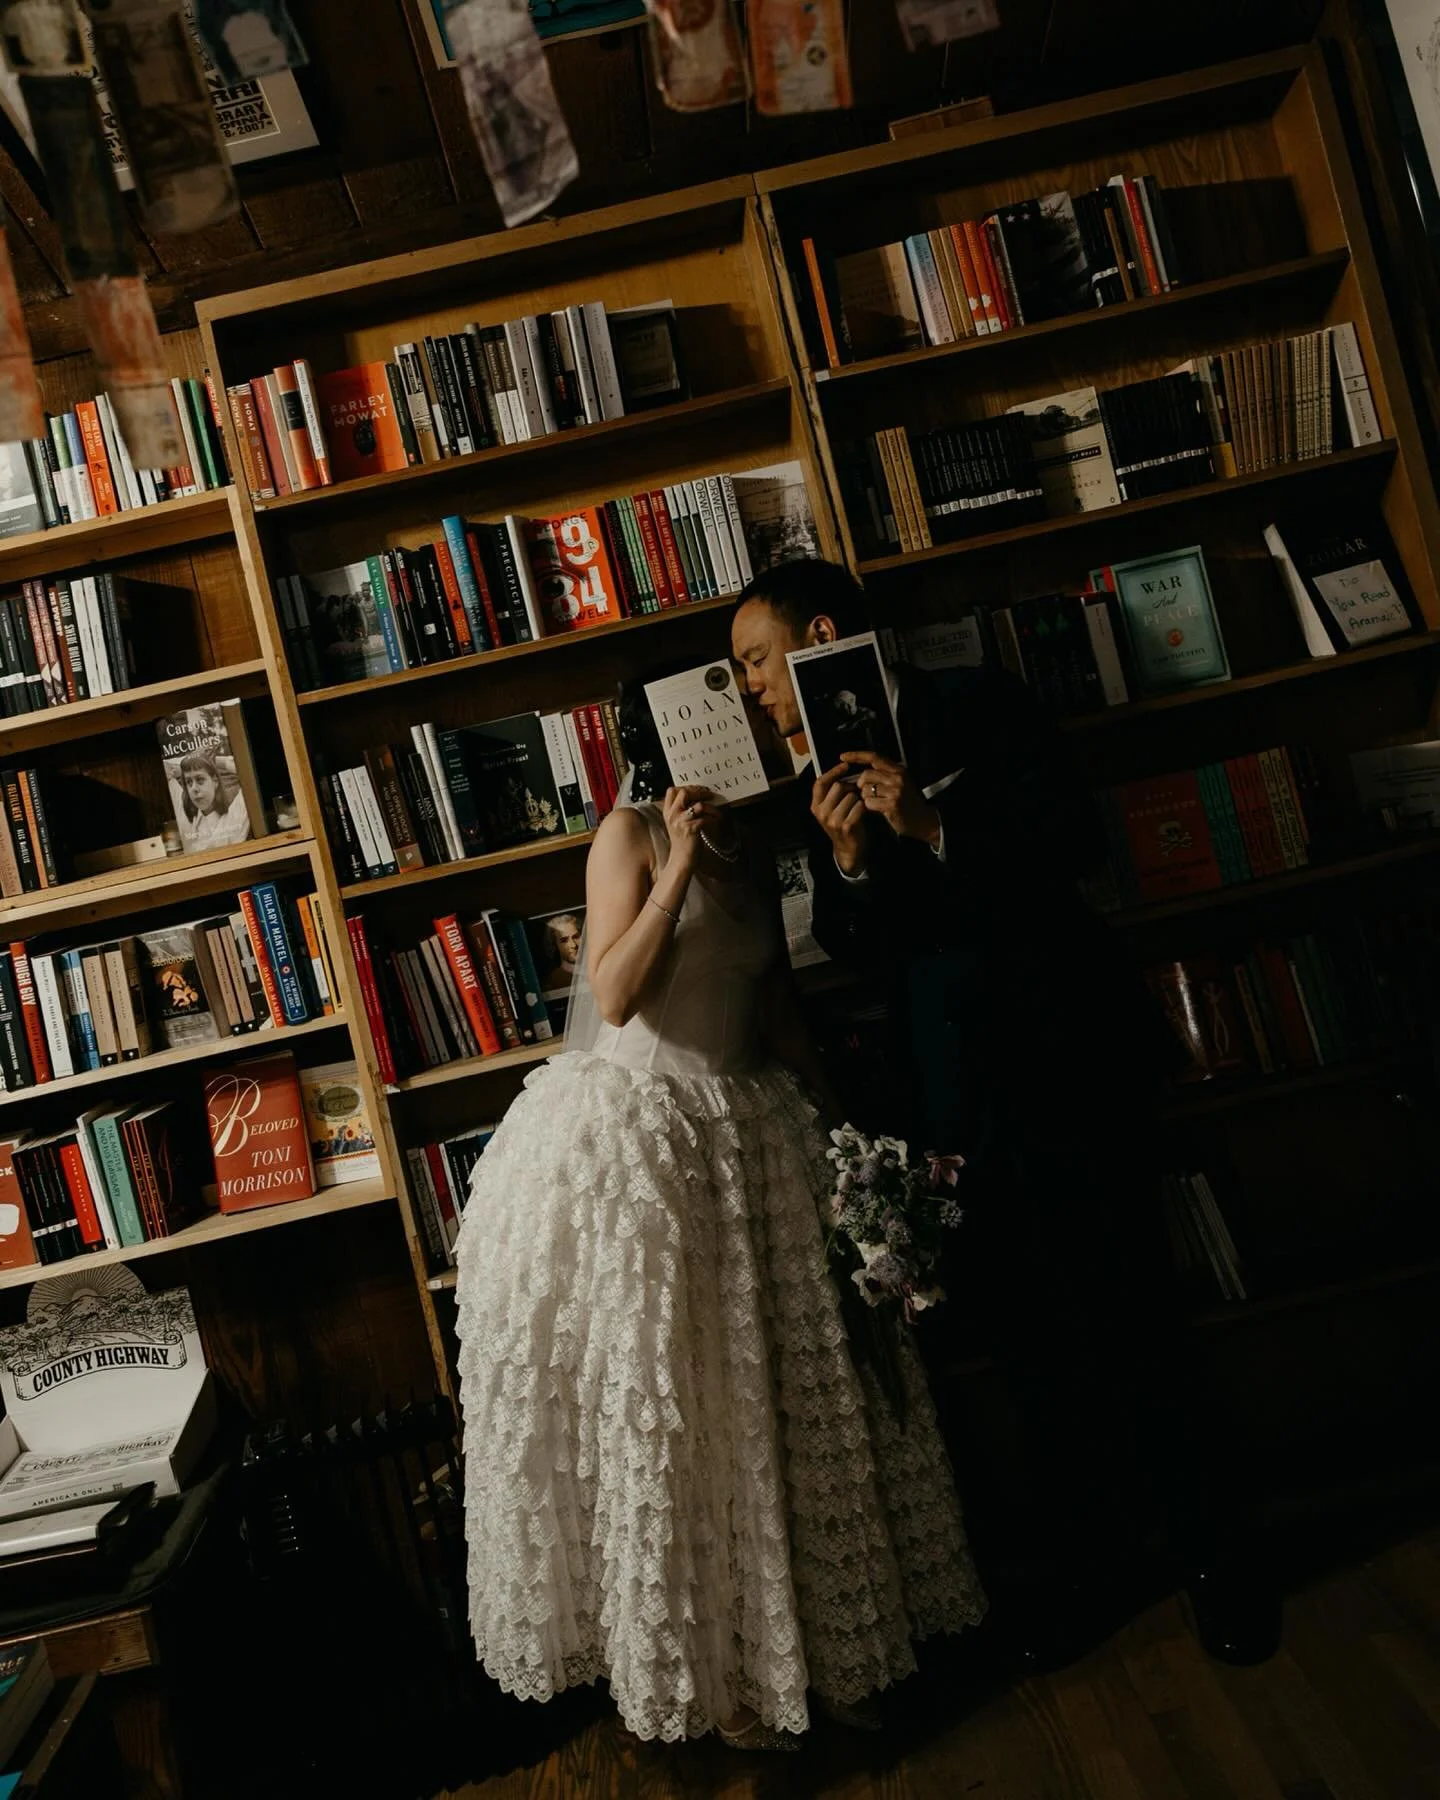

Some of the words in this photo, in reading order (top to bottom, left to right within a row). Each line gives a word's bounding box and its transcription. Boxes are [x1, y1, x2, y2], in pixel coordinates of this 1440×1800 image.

[230, 399, 241, 427] MOWAT
[244, 402, 256, 431] MOWAT
[331, 393, 385, 414] FARLEY
[333, 406, 388, 428] MOWAT
[694, 481, 714, 532] ORWELL
[707, 478, 727, 529] ORWELL
[721, 474, 740, 525] ORWELL
[1304, 534, 1370, 565] ZOHAR
[498, 542, 521, 606] PRECIPICE
[1139, 573, 1183, 596] WAR
[1328, 592, 1357, 614] You
[1359, 584, 1391, 605] Read
[1141, 603, 1199, 628] PEACE
[791, 651, 812, 661] Seamus
[577, 710, 587, 727] PHILIP
[591, 709, 602, 726] PHILIP
[658, 689, 737, 727] JOAN
[166, 718, 208, 737] Carson
[581, 727, 590, 741] ROTH
[595, 726, 605, 740] ROTH
[665, 713, 745, 748] DIDION
[163, 734, 221, 757] McCullers
[672, 752, 694, 764] THE
[700, 741, 730, 755] YEAR
[734, 735, 749, 745] OF
[677, 751, 756, 783] MAGICAL
[711, 770, 761, 792] NKING
[4, 782, 25, 823] FULFILLMENT
[15, 827, 26, 840] ALEC
[26, 772, 38, 798] STATION
[32, 798, 43, 821] ELEVEN
[262, 892, 279, 926] HILARY
[270, 926, 288, 962] MANTEL
[442, 919, 466, 954] TORN
[12, 953, 31, 986] TOUGH
[242, 895, 262, 950] RECESSIONAL
[261, 966, 274, 992] DAVID
[269, 993, 283, 1023] MAMET
[453, 952, 478, 992] APART
[19, 985, 36, 1007] GUY
[285, 990, 295, 1008] LIGHT
[291, 987, 301, 1007] MIRROR
[205, 1074, 299, 1157] BELOVED
[97, 1126, 107, 1144] AND
[106, 1124, 115, 1141] THE
[109, 1140, 122, 1172] MASTER
[251, 1146, 292, 1168] TONI
[220, 1166, 306, 1197] MORRISON
[33, 1350, 101, 1393] COUNTY
[97, 1345, 169, 1366] HIGHWAY
[32, 1491, 79, 1506] AMERICA'S
[81, 1487, 103, 1496] ONLY
